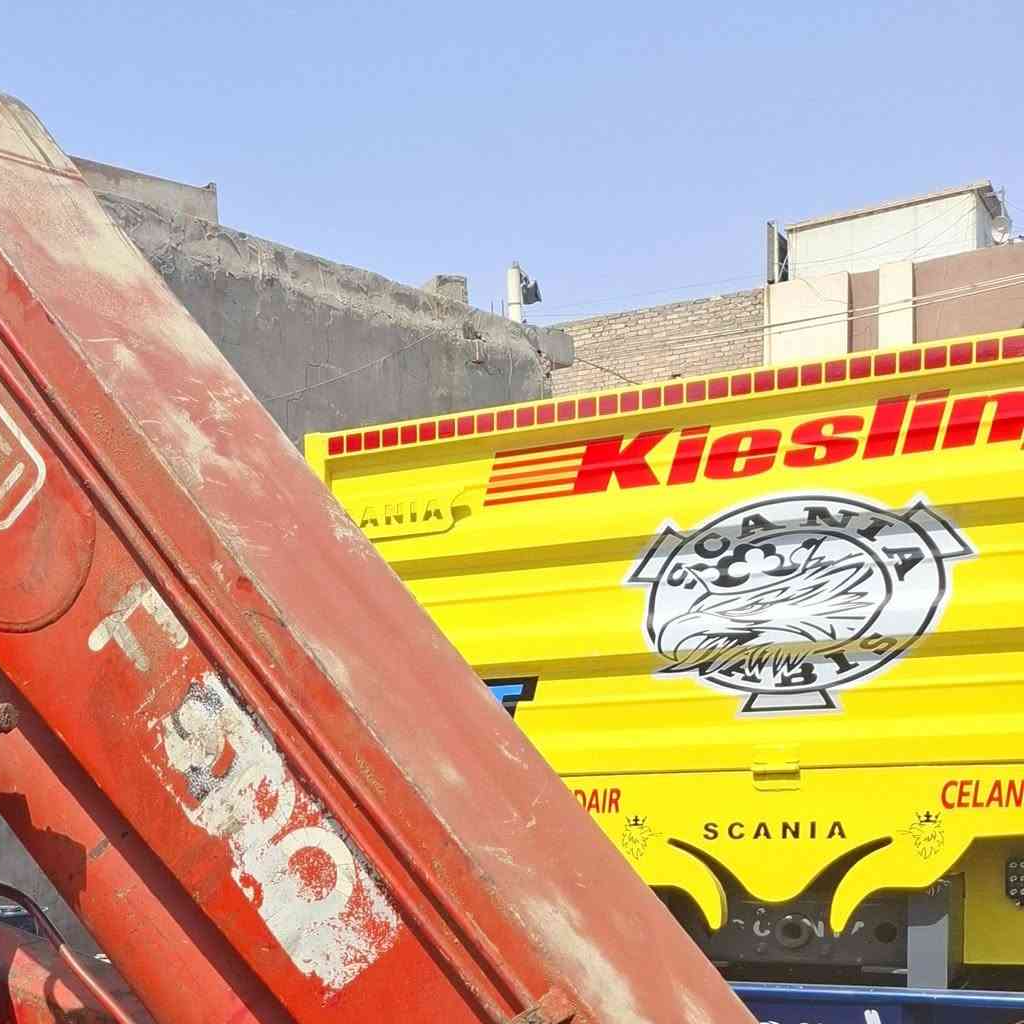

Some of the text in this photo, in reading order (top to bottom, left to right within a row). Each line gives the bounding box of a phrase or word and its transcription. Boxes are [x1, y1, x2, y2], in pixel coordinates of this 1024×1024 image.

[573, 388, 1024, 496] Kieslin
[360, 498, 443, 528] ANIA
[666, 506, 926, 590] SCANIA
[702, 820, 847, 842] SCANIA
